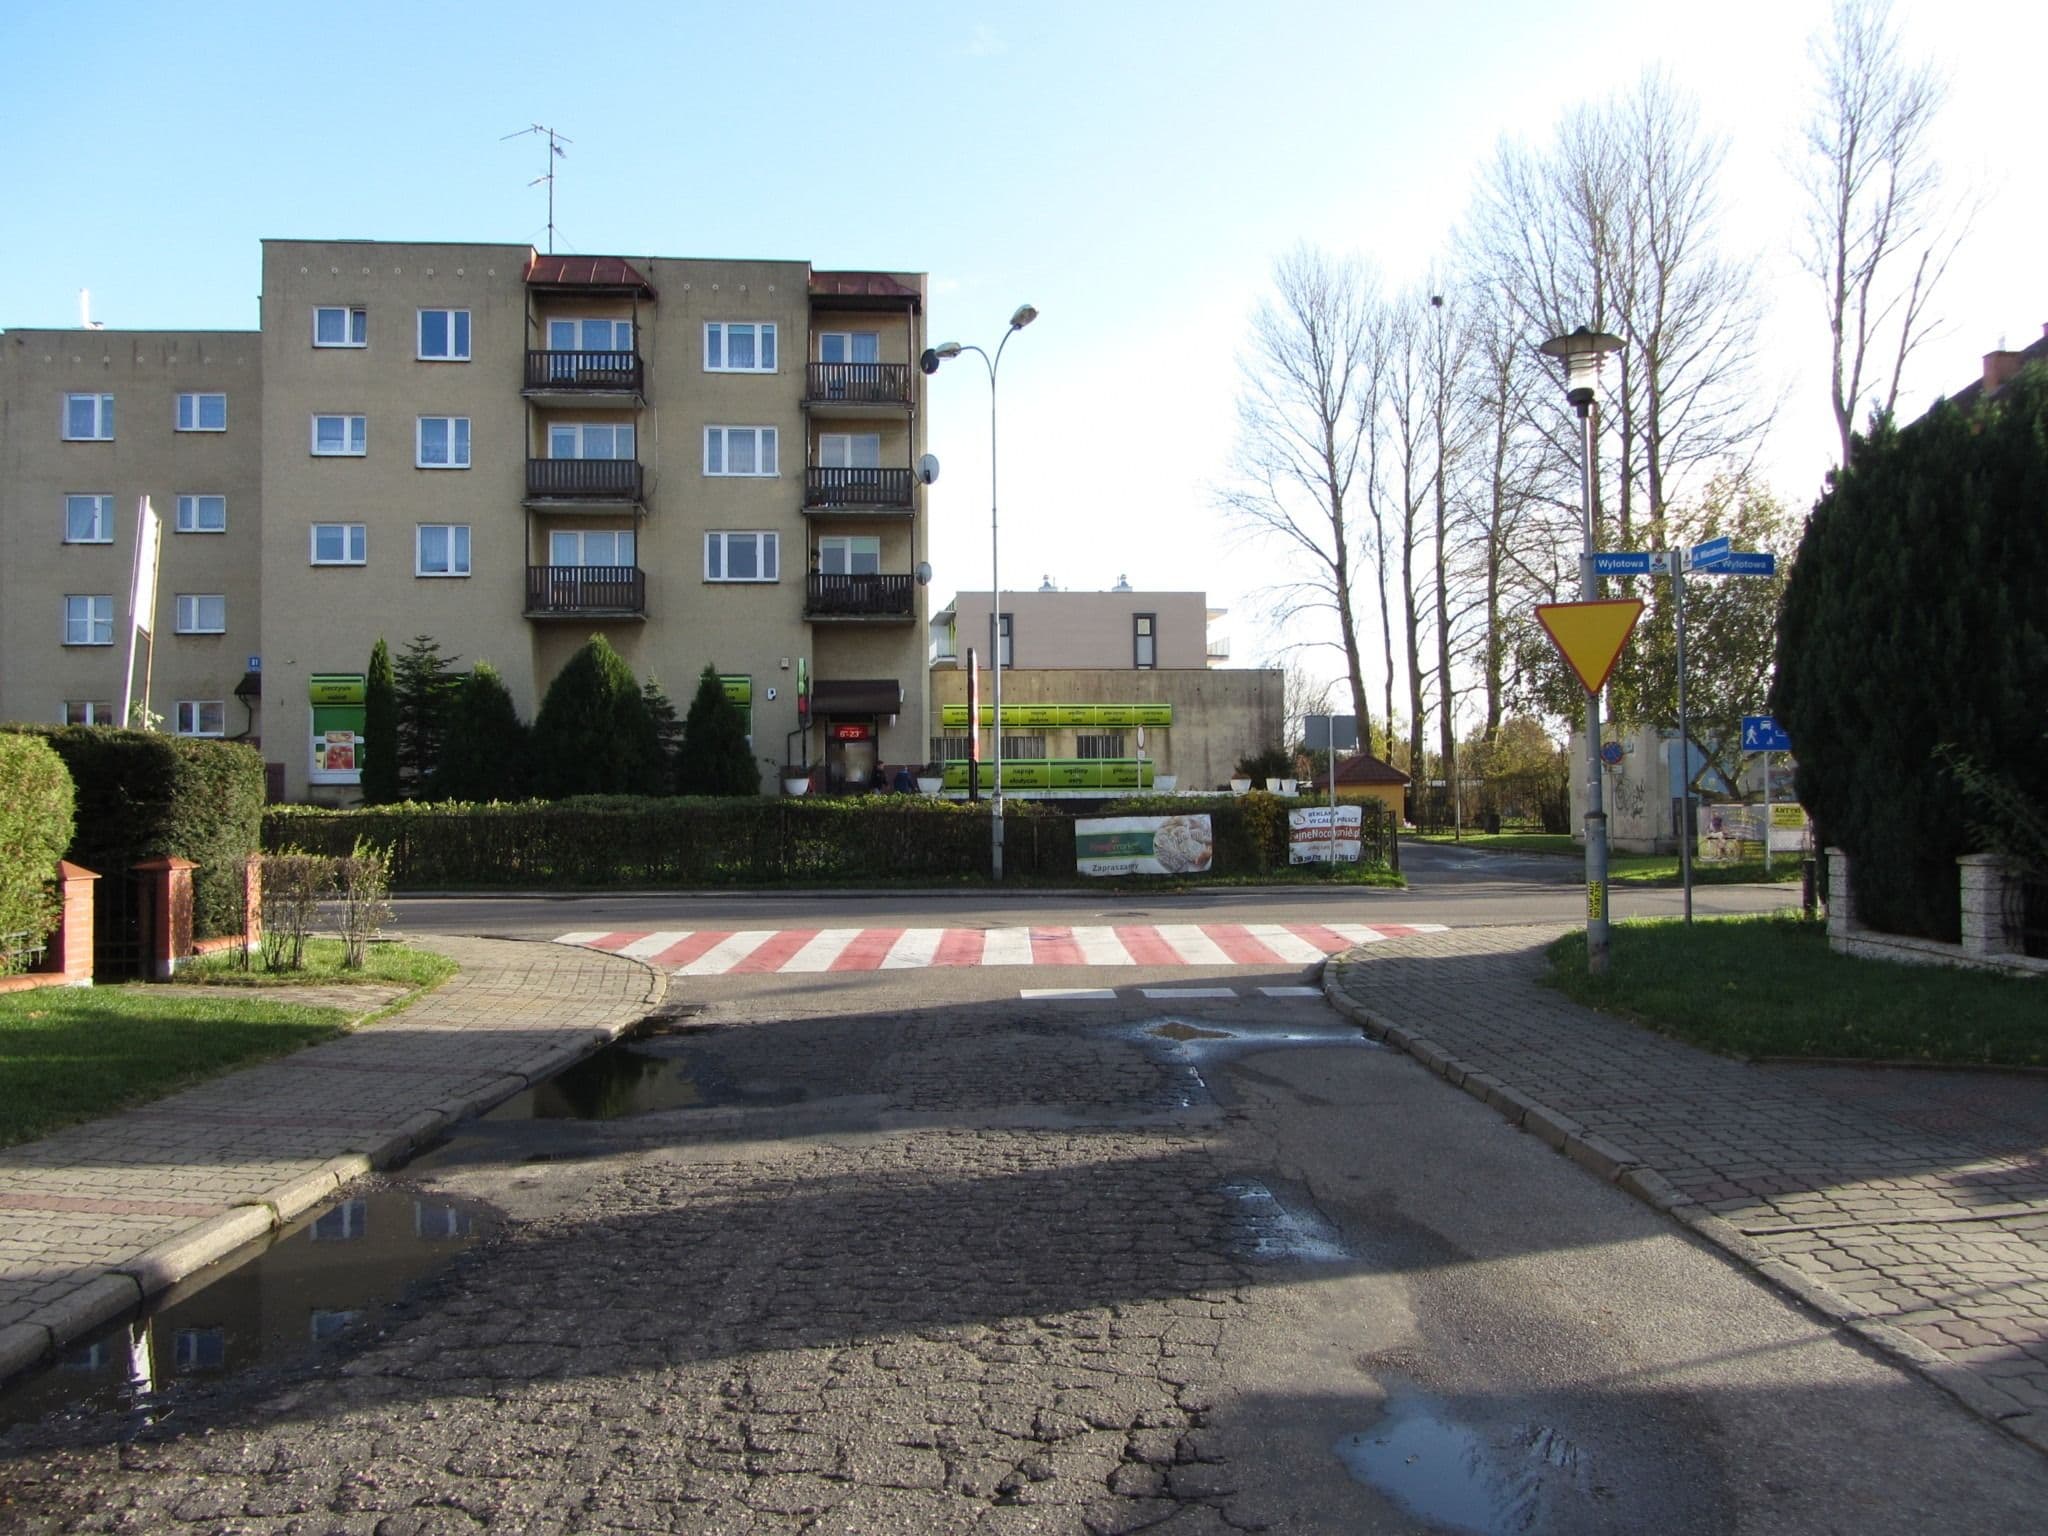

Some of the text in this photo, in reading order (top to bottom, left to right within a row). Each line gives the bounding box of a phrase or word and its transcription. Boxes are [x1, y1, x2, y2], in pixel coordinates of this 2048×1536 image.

[1598, 560, 1644, 570] Wylotowa
[1722, 560, 1766, 570] Wylotowa
[1092, 863, 1139, 872] Zapraszamy
